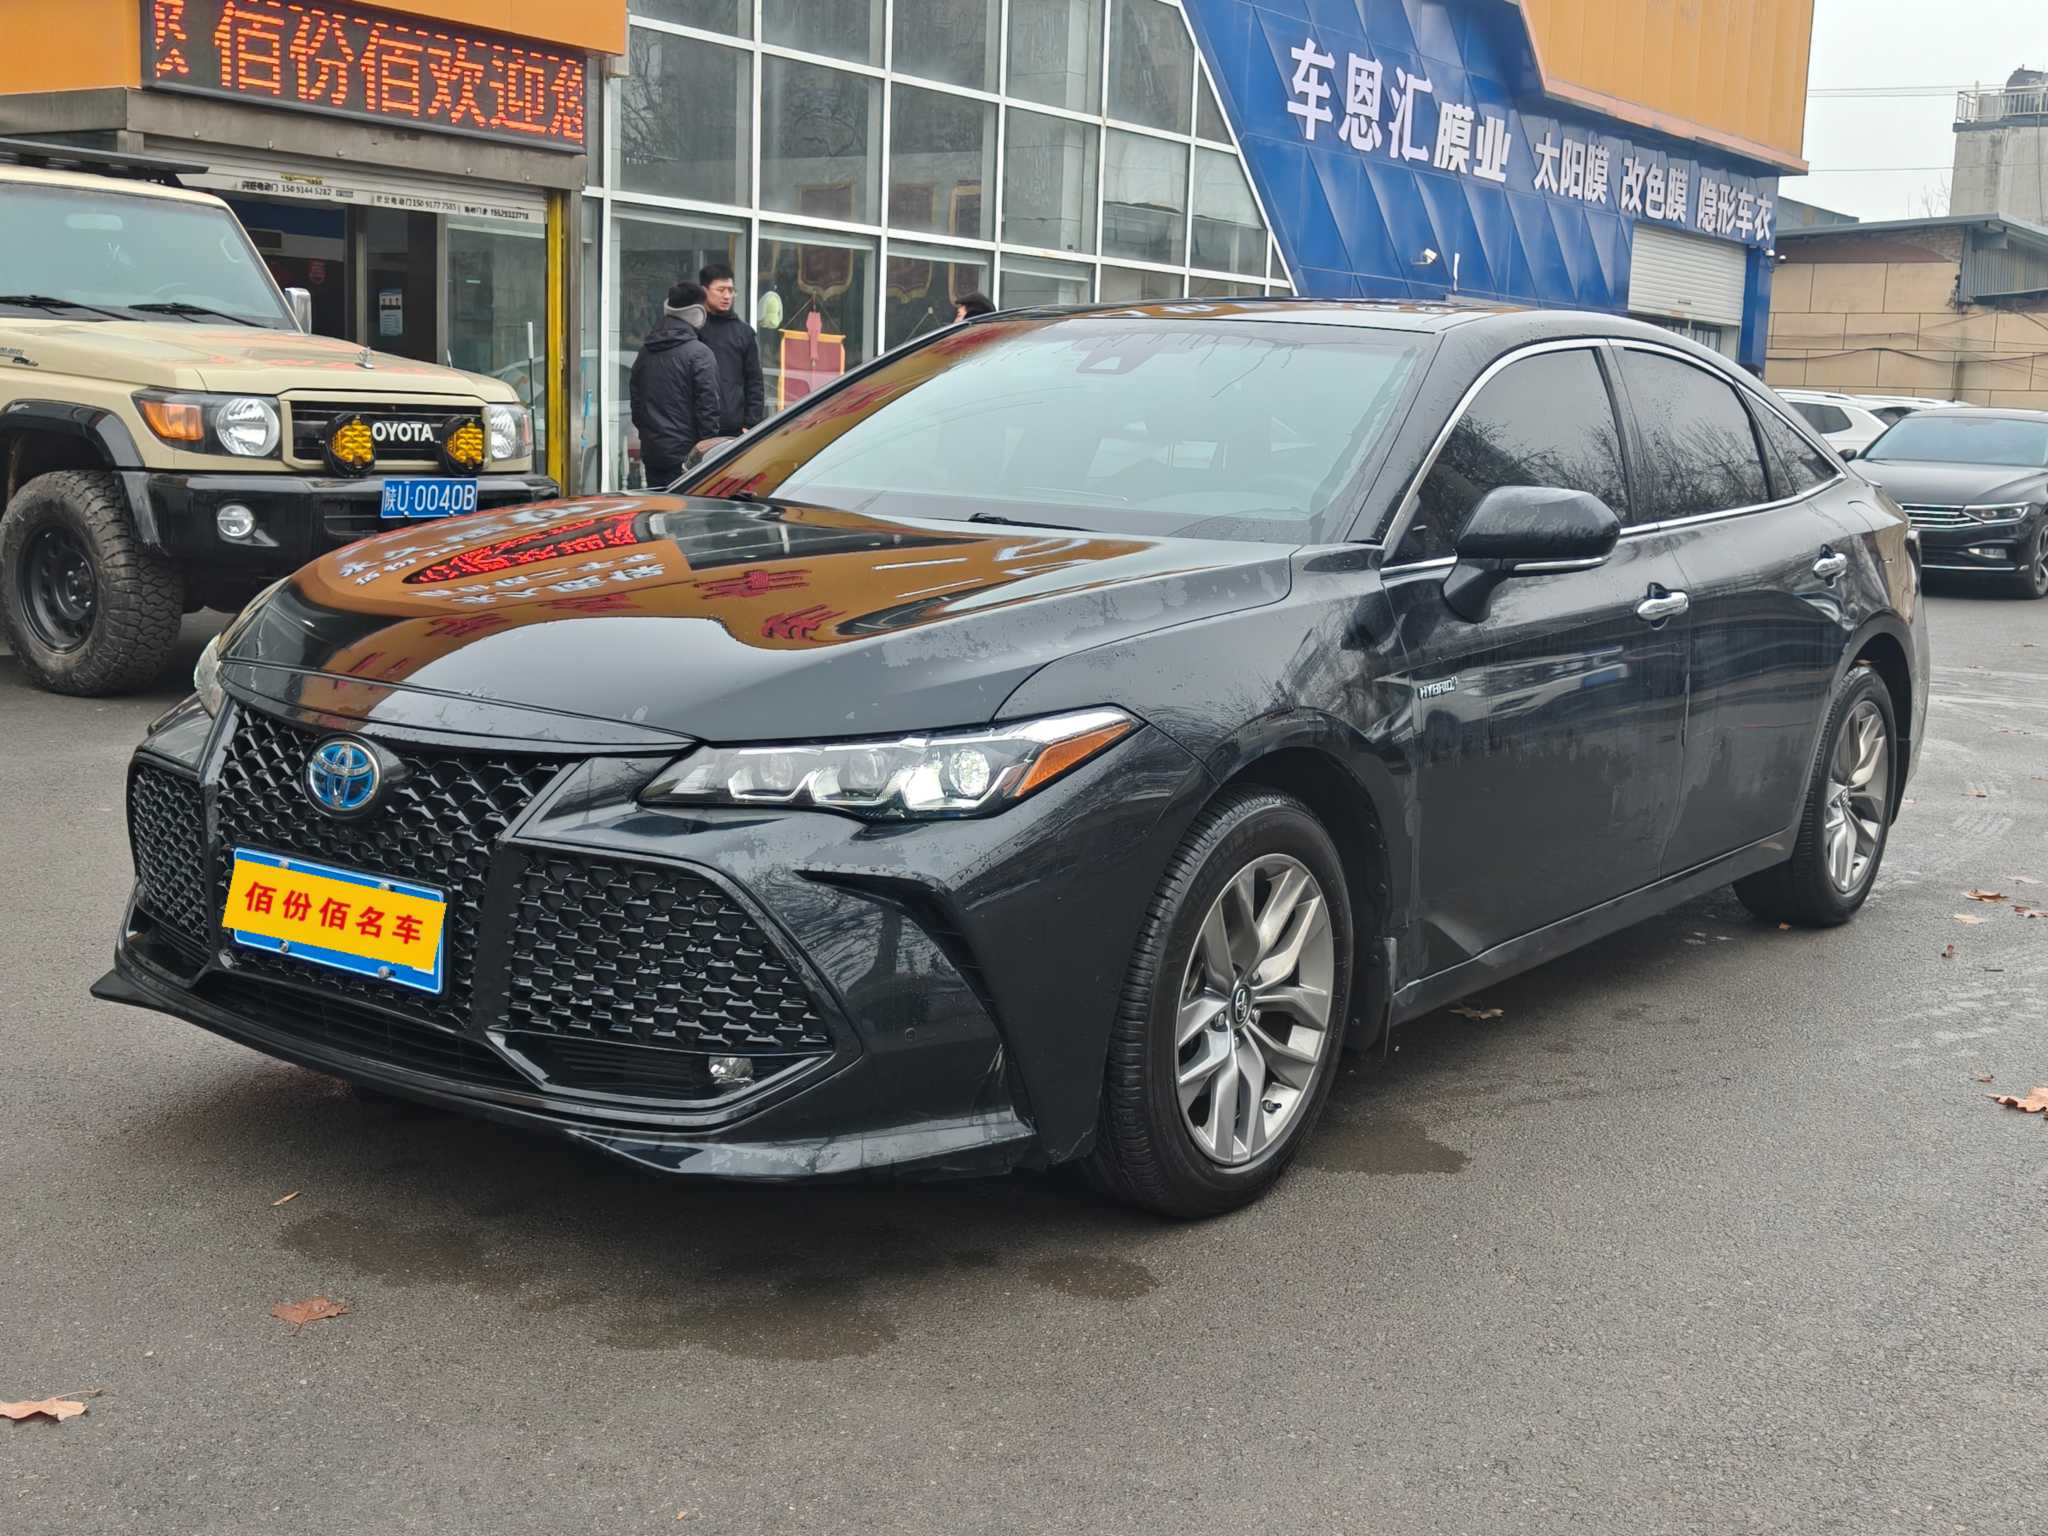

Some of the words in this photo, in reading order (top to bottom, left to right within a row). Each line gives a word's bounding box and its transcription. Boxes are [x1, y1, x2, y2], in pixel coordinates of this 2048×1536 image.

[1287, 38, 1511, 183] 车恩汇膜业
[1534, 132, 1610, 204] 太阳膜
[1620, 156, 1688, 223] 改色膜
[1697, 177, 1774, 241] 隐形车衣
[372, 422, 434, 442] OYOTA
[1420, 678, 1457, 698] HYBRID
